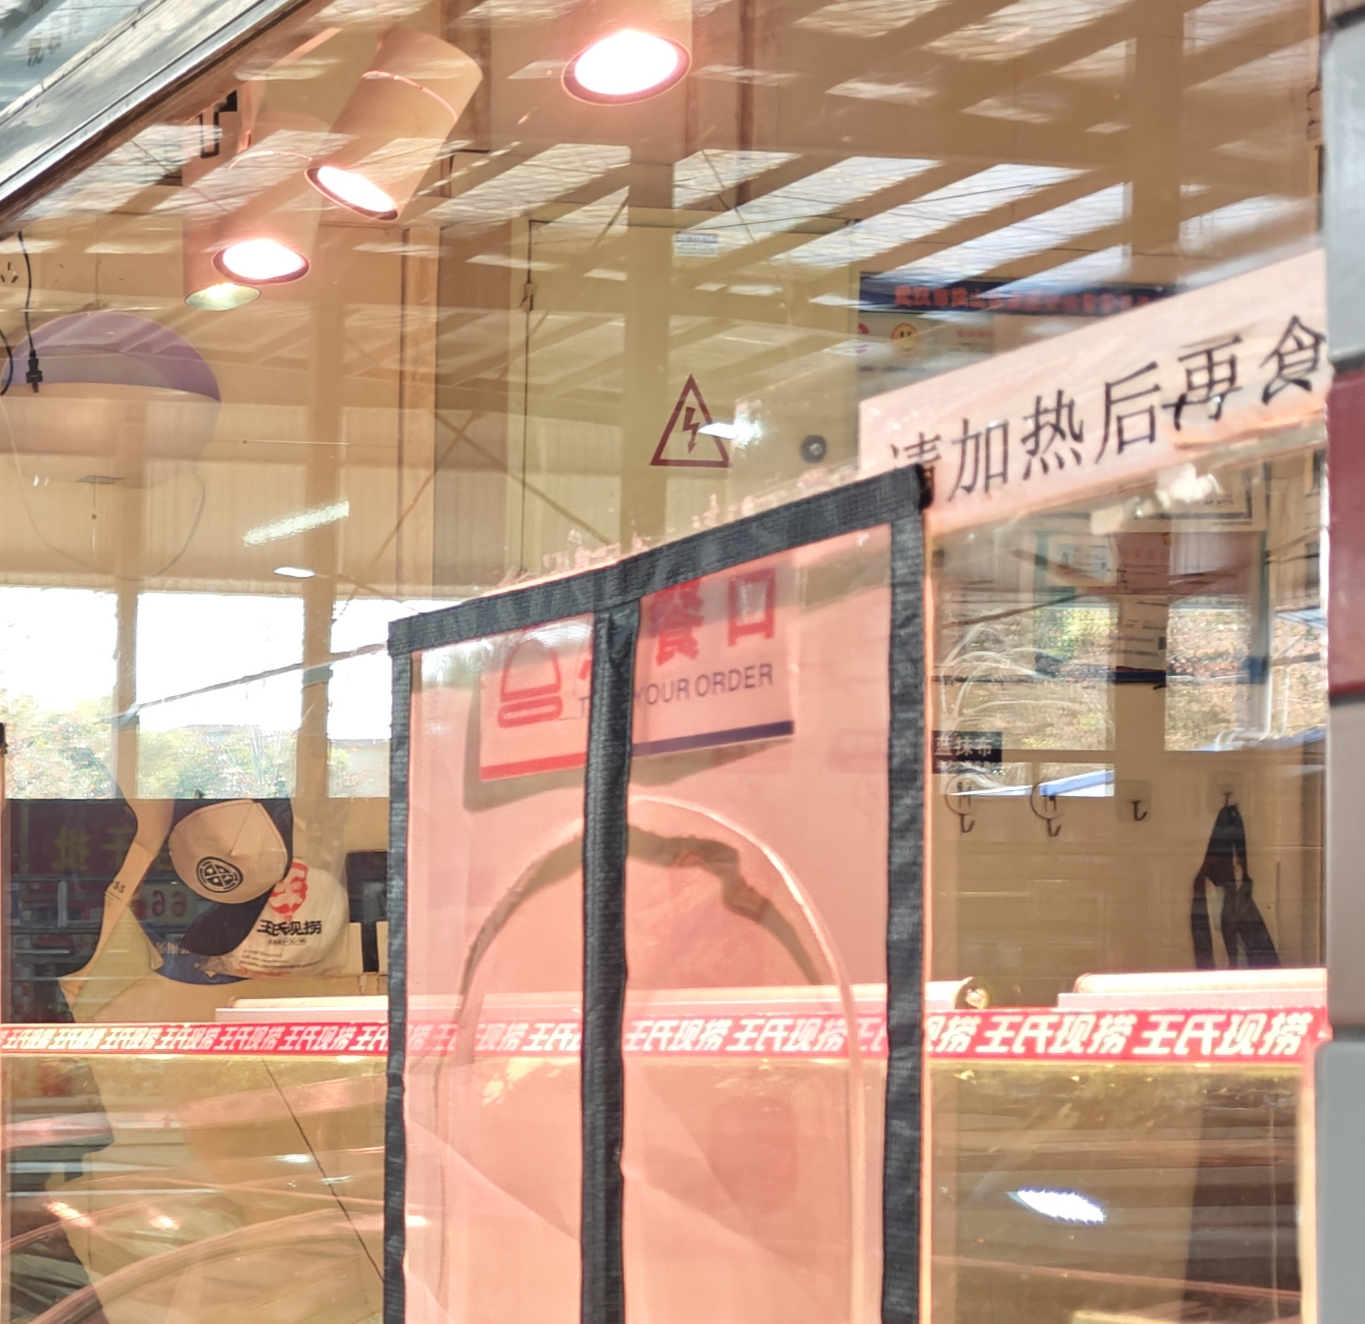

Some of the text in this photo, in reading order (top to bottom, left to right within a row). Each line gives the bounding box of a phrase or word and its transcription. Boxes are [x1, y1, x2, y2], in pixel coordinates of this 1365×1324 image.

[695, 663, 774, 698] ORDER
[256, 919, 323, 937] 王氏现捞
[6, 1029, 51, 1050] 王氏现捞
[49, 1028, 105, 1050] 王氏现捞
[102, 1028, 159, 1050] 王氏现捞
[157, 1027, 215, 1050] 王氏现捞
[214, 1026, 283, 1051] 王氏现捞
[277, 1025, 357, 1051] 王氏现捞
[624, 1018, 730, 1053] 王氏现捞
[724, 1017, 849, 1053] 王氏现捞
[976, 1013, 1138, 1055] 王氏现捞
[1132, 1012, 1313, 1056] 王氏现捞
